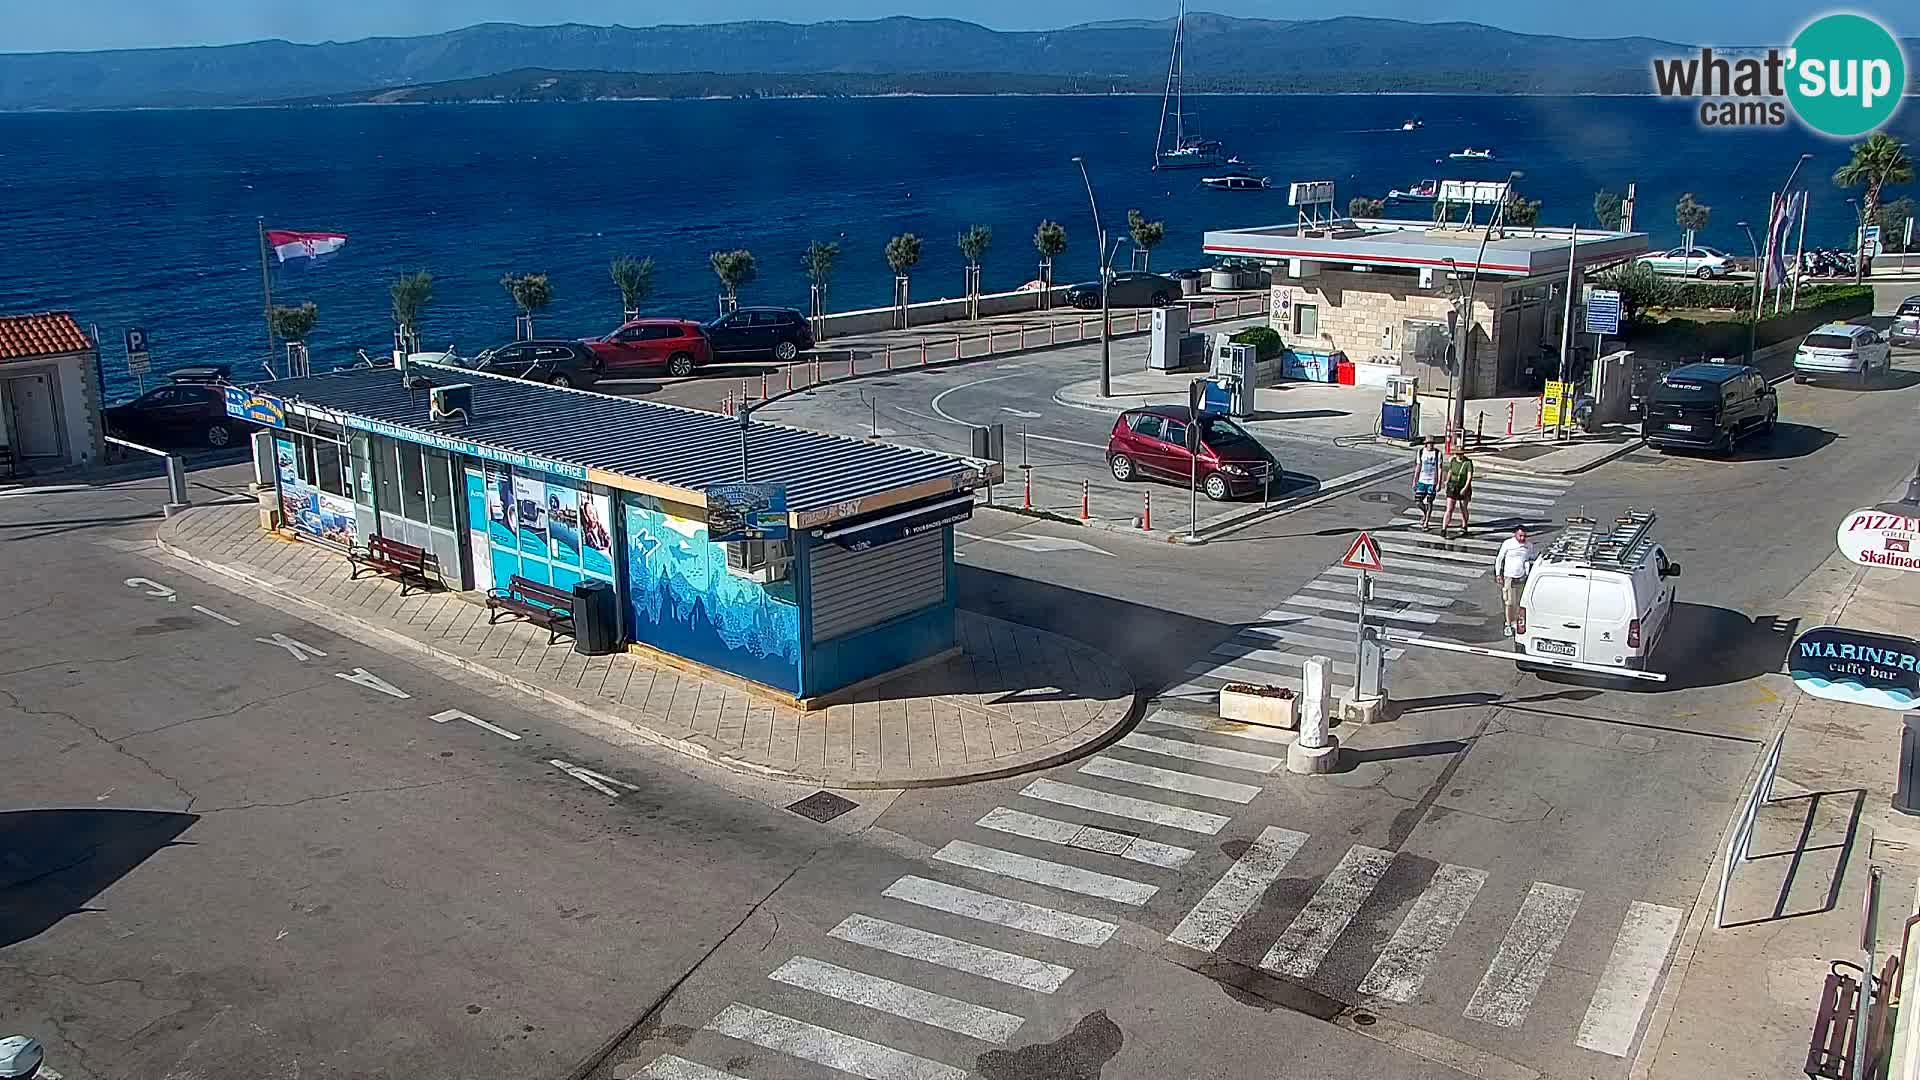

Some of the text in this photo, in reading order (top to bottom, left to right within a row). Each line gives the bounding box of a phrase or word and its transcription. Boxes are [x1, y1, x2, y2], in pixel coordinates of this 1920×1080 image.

[130, 332, 142, 350] P
[435, 438, 467, 453] POSTAJA
[477, 446, 492, 458] BUS
[494, 449, 526, 465] STATION
[528, 456, 554, 471] TICKET
[555, 463, 582, 477] OFFICE
[1848, 515, 1920, 533] PIZZE
[1870, 666, 1897, 680] bar
